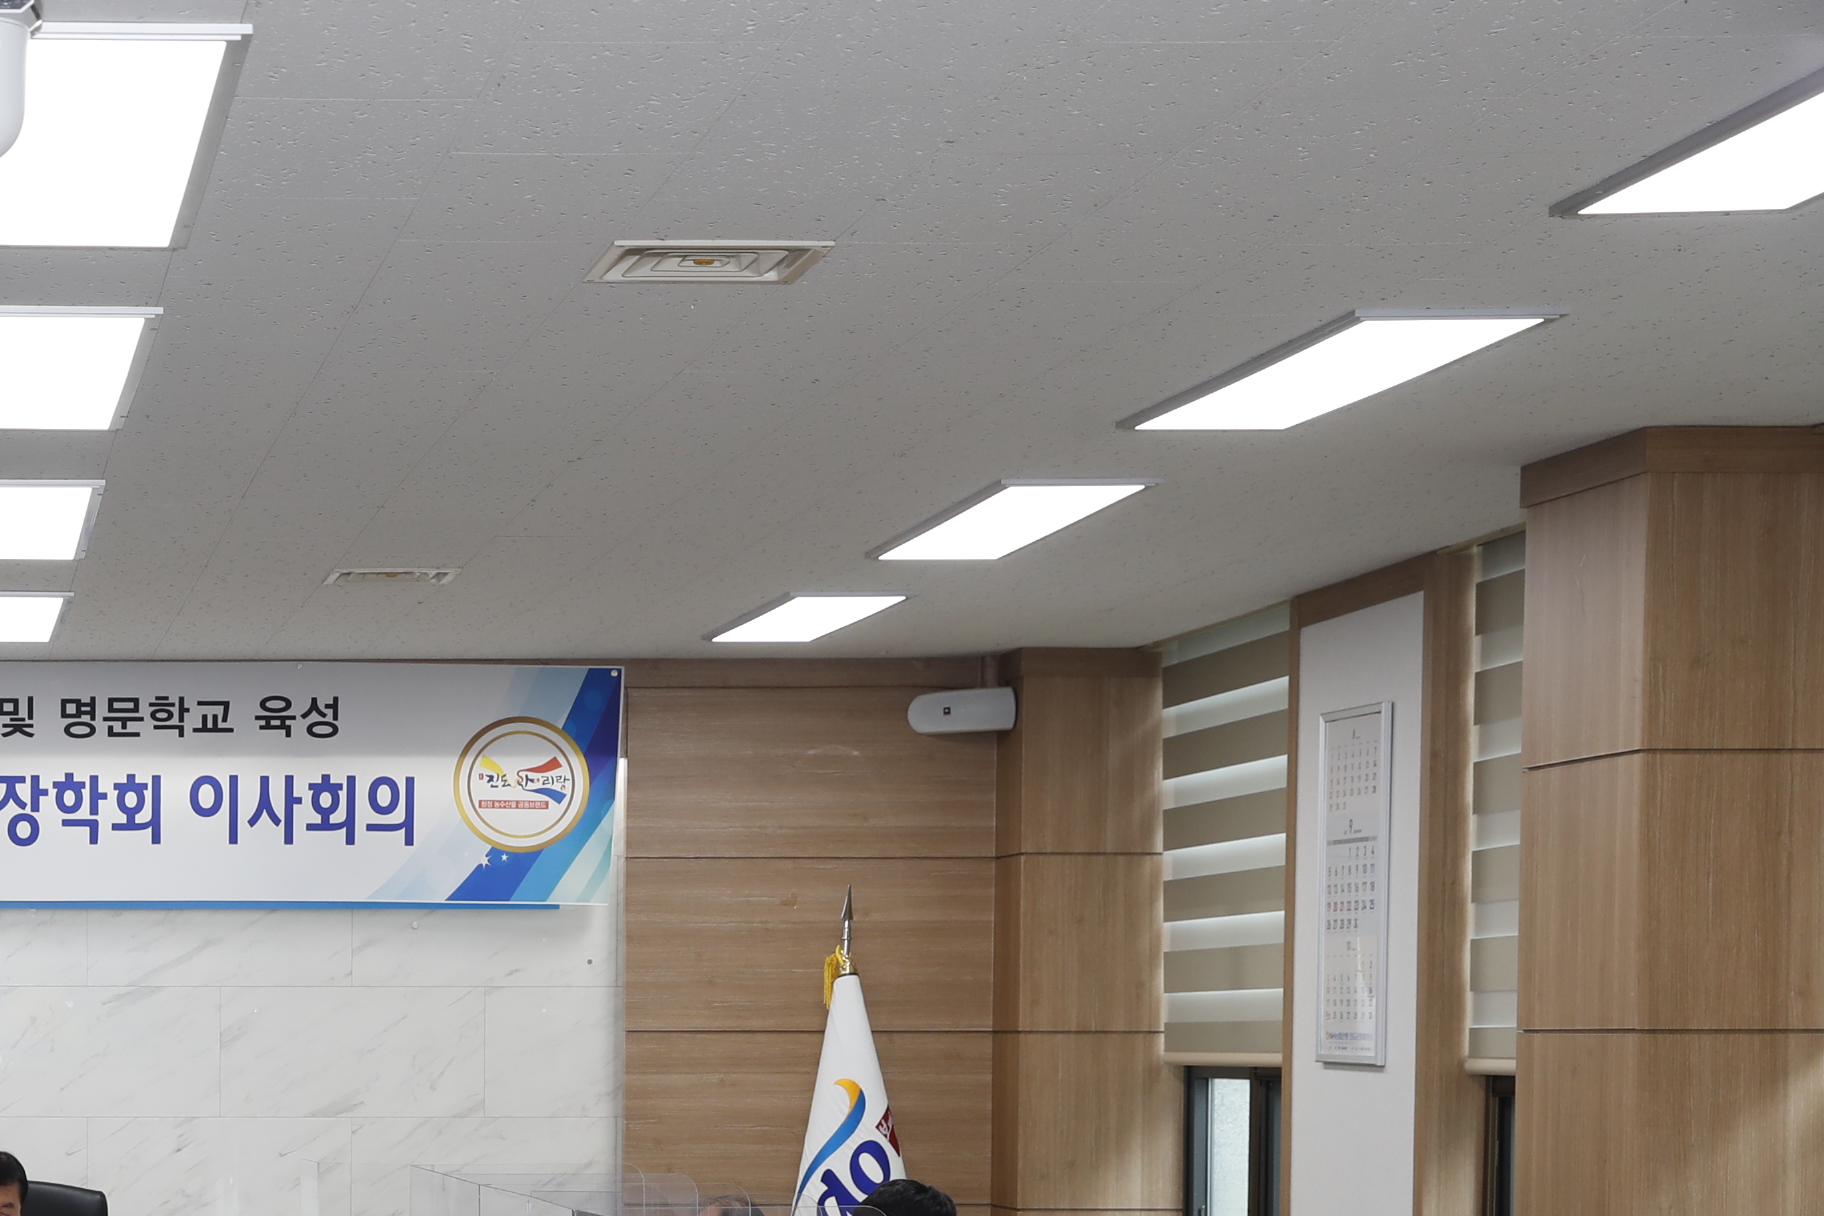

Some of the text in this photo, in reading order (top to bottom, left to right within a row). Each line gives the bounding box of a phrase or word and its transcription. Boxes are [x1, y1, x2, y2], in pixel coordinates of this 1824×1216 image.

[60, 695, 235, 739] 명문학교
[254, 695, 339, 739] 육성
[189, 773, 415, 847] 이사회의
